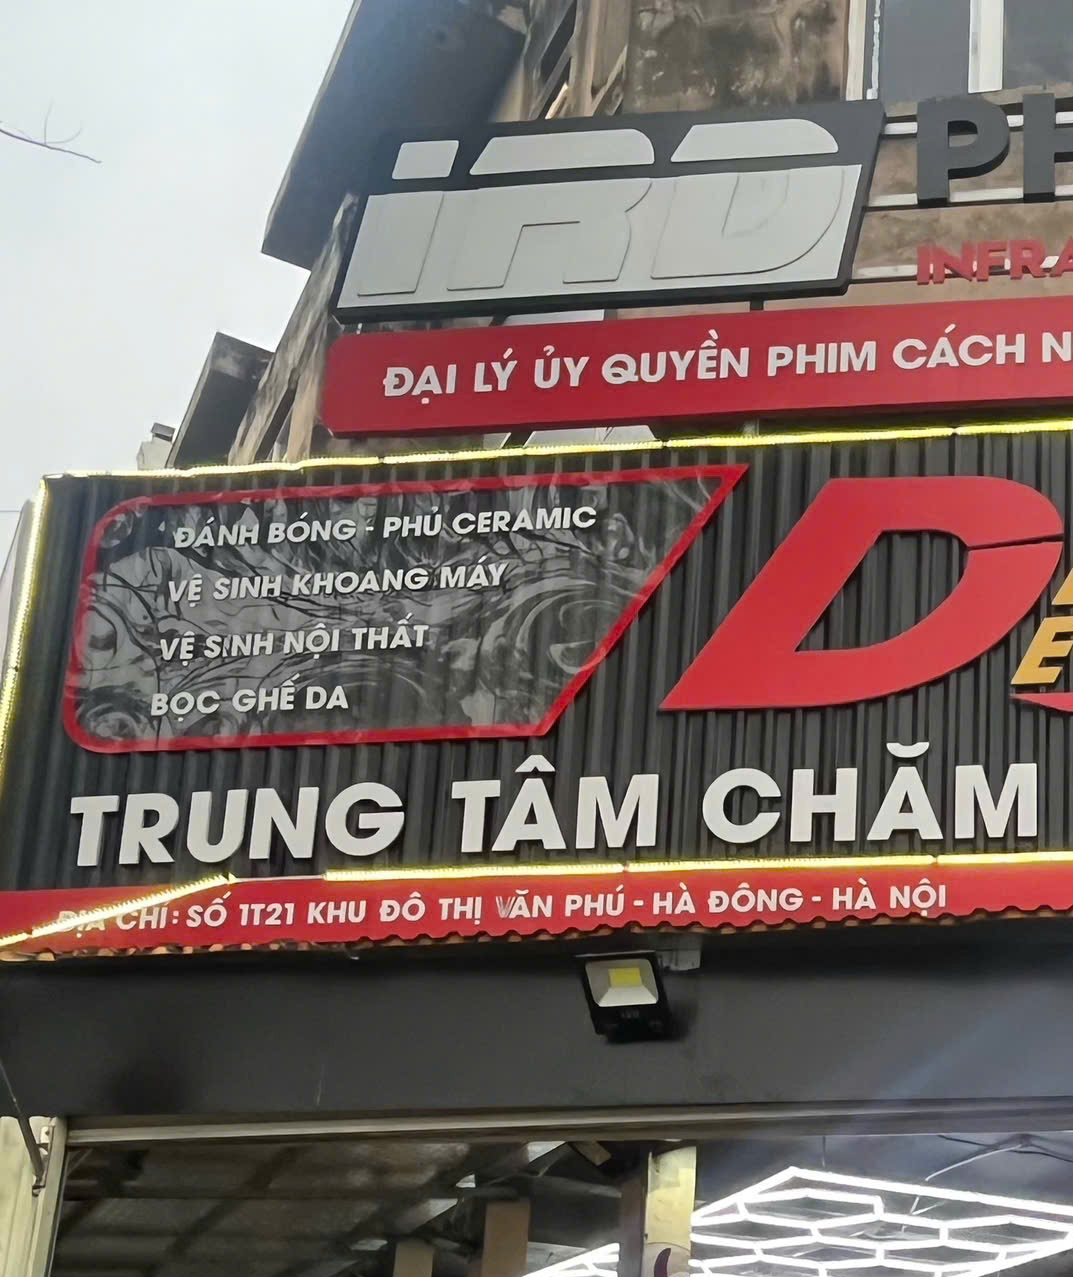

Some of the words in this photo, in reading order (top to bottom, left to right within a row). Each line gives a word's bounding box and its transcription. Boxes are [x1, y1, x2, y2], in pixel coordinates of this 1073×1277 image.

[383, 360, 457, 404] ĐẠI
[474, 345, 514, 393] LÝ
[534, 345, 590, 390] ỦY
[602, 329, 750, 386] QUYỀN
[767, 341, 878, 378] PHIM
[893, 323, 1026, 370] CÁCH
[173, 516, 260, 549] ĐÁNH
[267, 512, 357, 544] BÓNG
[383, 506, 442, 539] PHỦ
[452, 506, 597, 535] CERAMIC
[168, 573, 203, 608] VỆ
[213, 574, 283, 600] SINH
[291, 568, 429, 596] KHOANG
[440, 555, 510, 589] MÁY
[160, 631, 195, 666] VỆ
[203, 632, 274, 659] SINH
[283, 623, 340, 660] NỘI
[351, 612, 430, 650] THẤT
[151, 690, 220, 722] BỌC
[231, 673, 300, 714] GHẾ
[305, 685, 349, 711] DA
[70, 782, 406, 868] TRUNG
[451, 755, 661, 854] TÂM
[702, 742, 1038, 845] CHĂM
[186, 891, 233, 929] SỐ
[239, 902, 295, 926] 1T21
[307, 899, 367, 925] KHU
[379, 892, 426, 922] ĐÔ
[438, 897, 483, 926] THỊ
[497, 889, 553, 919] VĂN
[564, 885, 625, 917] PHÚ
[653, 882, 697, 915] HÀ
[707, 882, 804, 913] ĐÔNG
[832, 878, 877, 911] HÀ
[889, 878, 947, 916] NỘI
